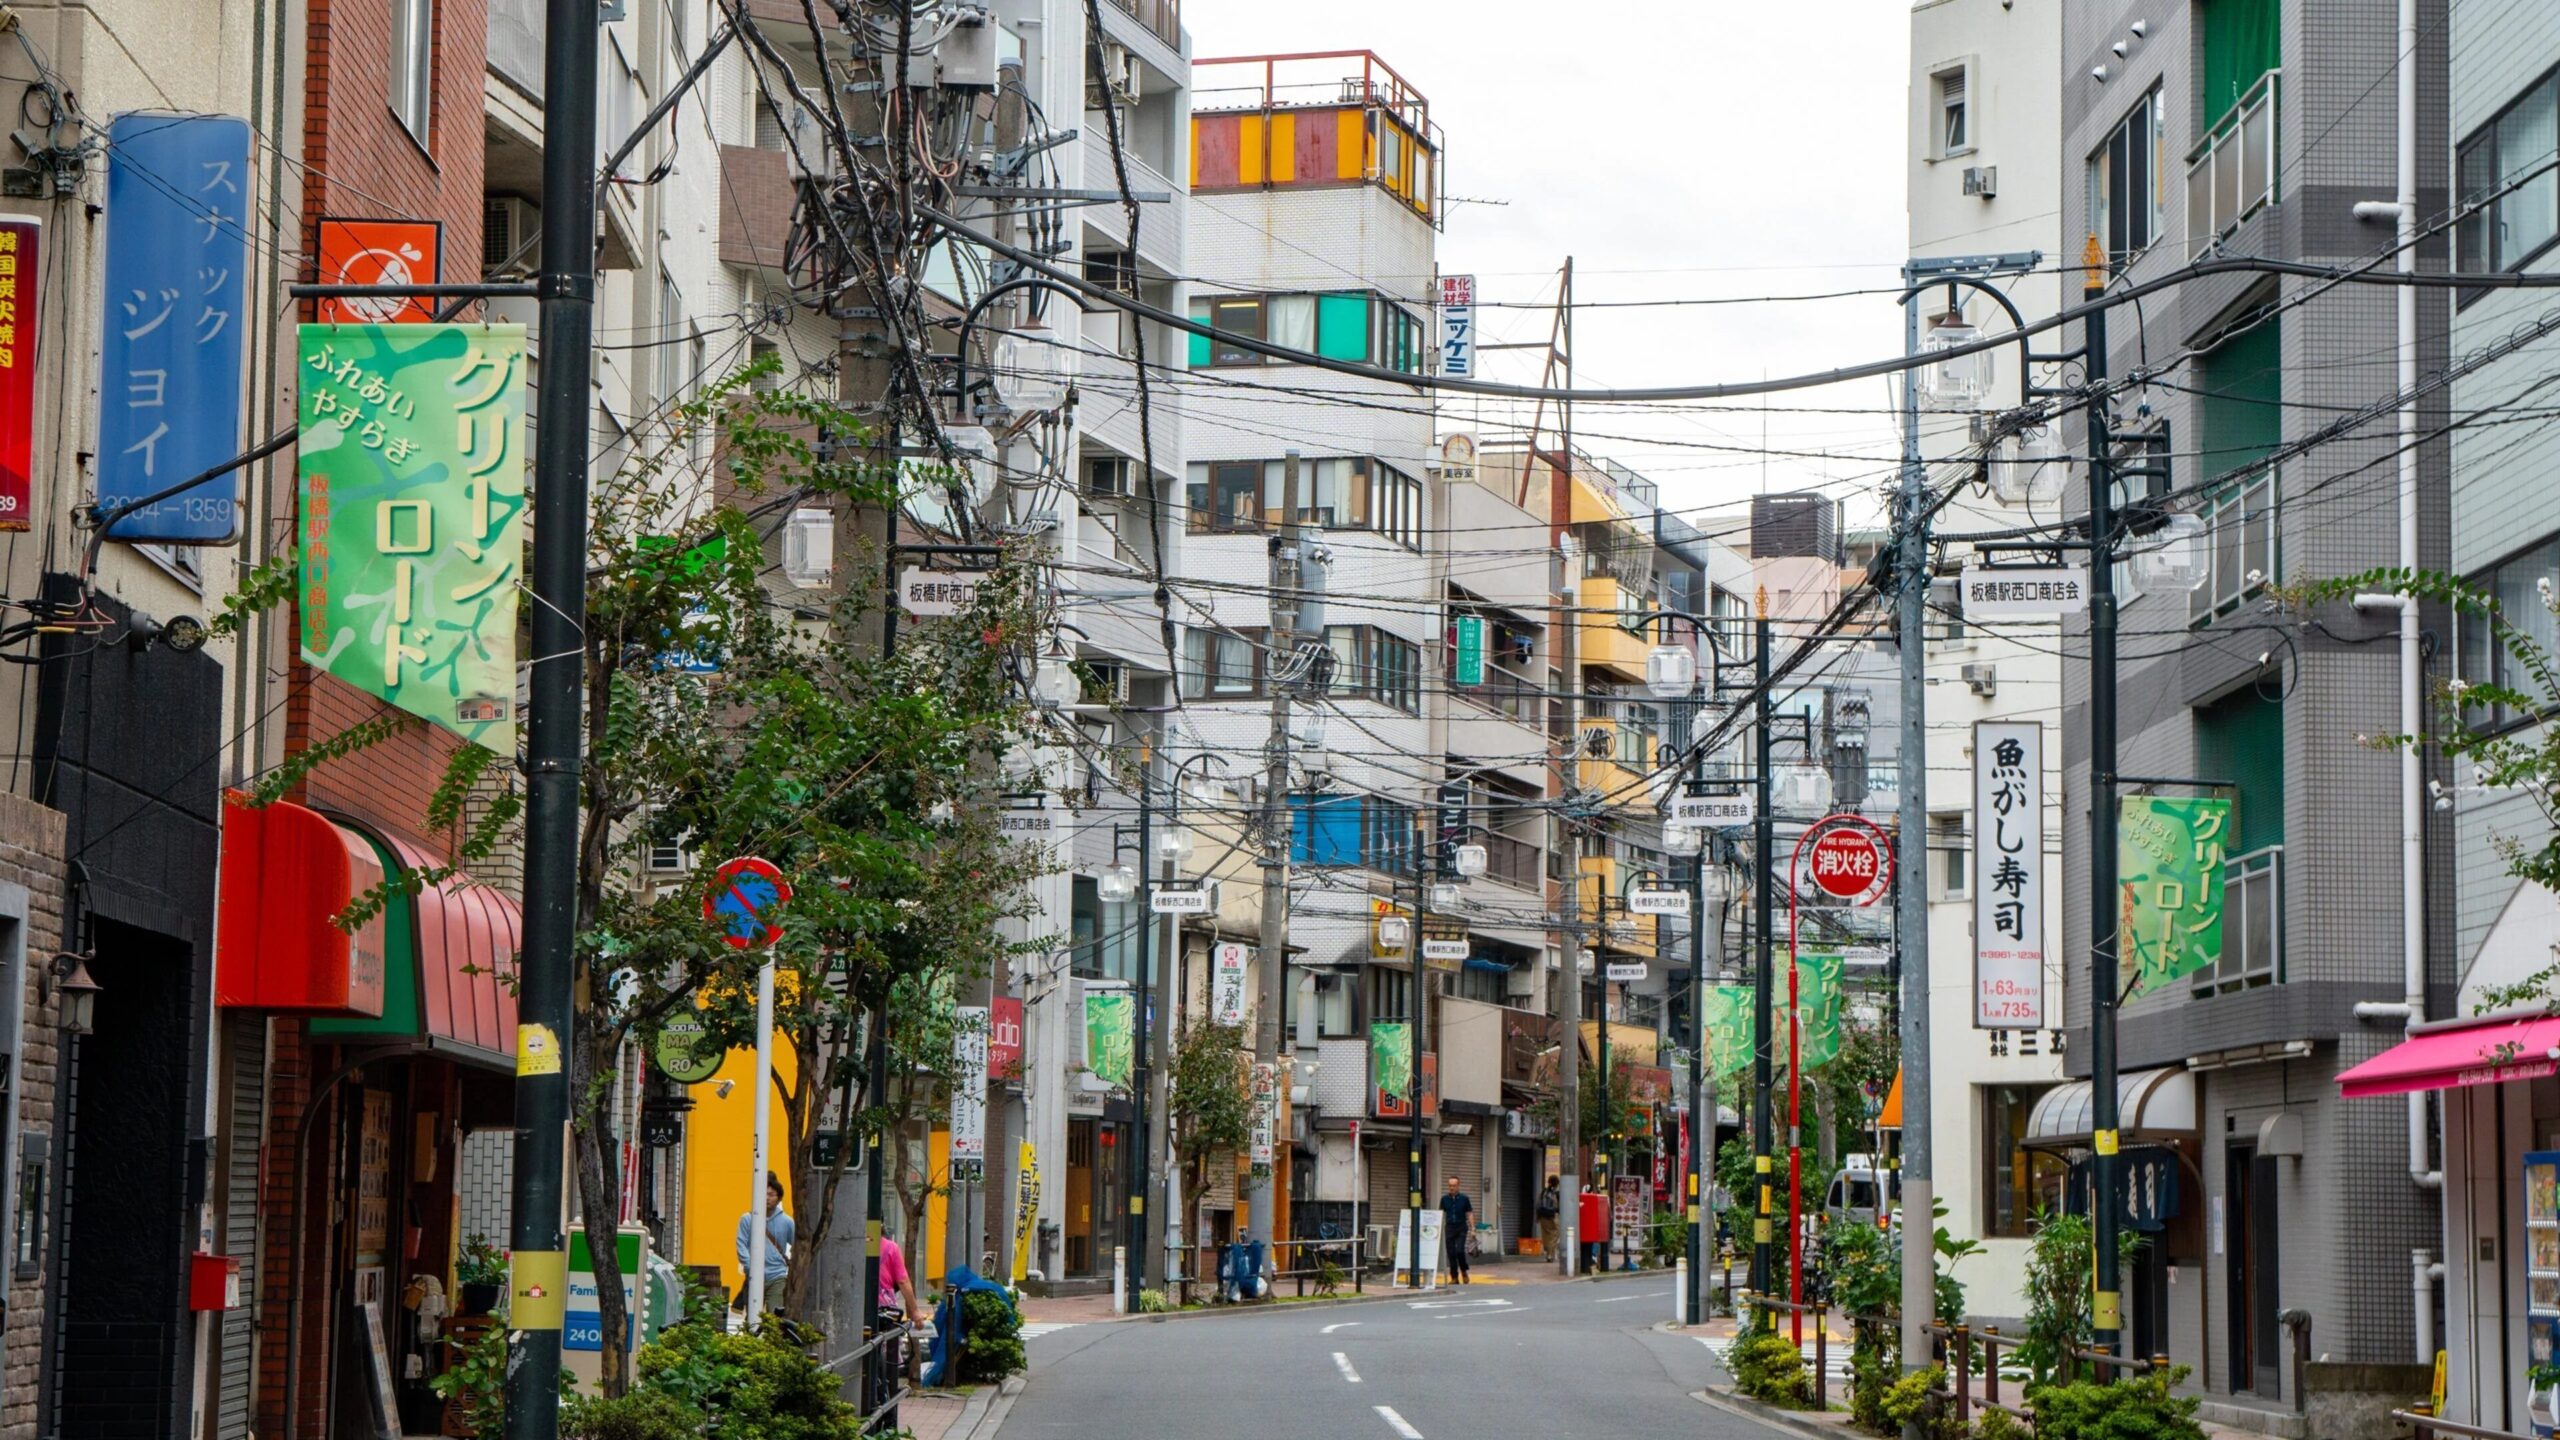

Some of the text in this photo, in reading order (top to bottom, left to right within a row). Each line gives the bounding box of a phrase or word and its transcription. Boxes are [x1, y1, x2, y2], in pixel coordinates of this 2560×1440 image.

[194, 159, 238, 346] スナック
[1444, 307, 1468, 374] ニッケミ
[307, 344, 416, 420] ふれあい
[311, 388, 421, 466] やすらぎ
[452, 346, 521, 602] グリーン
[307, 473, 330, 653] 板橋駅西口商店会
[376, 500, 432, 686] ロード
[1970, 580, 2080, 603] 板橋駅西口商店会
[1678, 804, 1748, 818] 板橋駅西口商店会
[1991, 738, 2030, 942] 魚がし寿司
[2126, 808, 2177, 846] ふれあい
[2127, 828, 2178, 866] やすらぎ
[1817, 849, 1874, 876] 消火栓
[2188, 809, 2225, 935] グリーン
[2156, 882, 2184, 974] ロード
[1815, 960, 1842, 1040] グリーン
